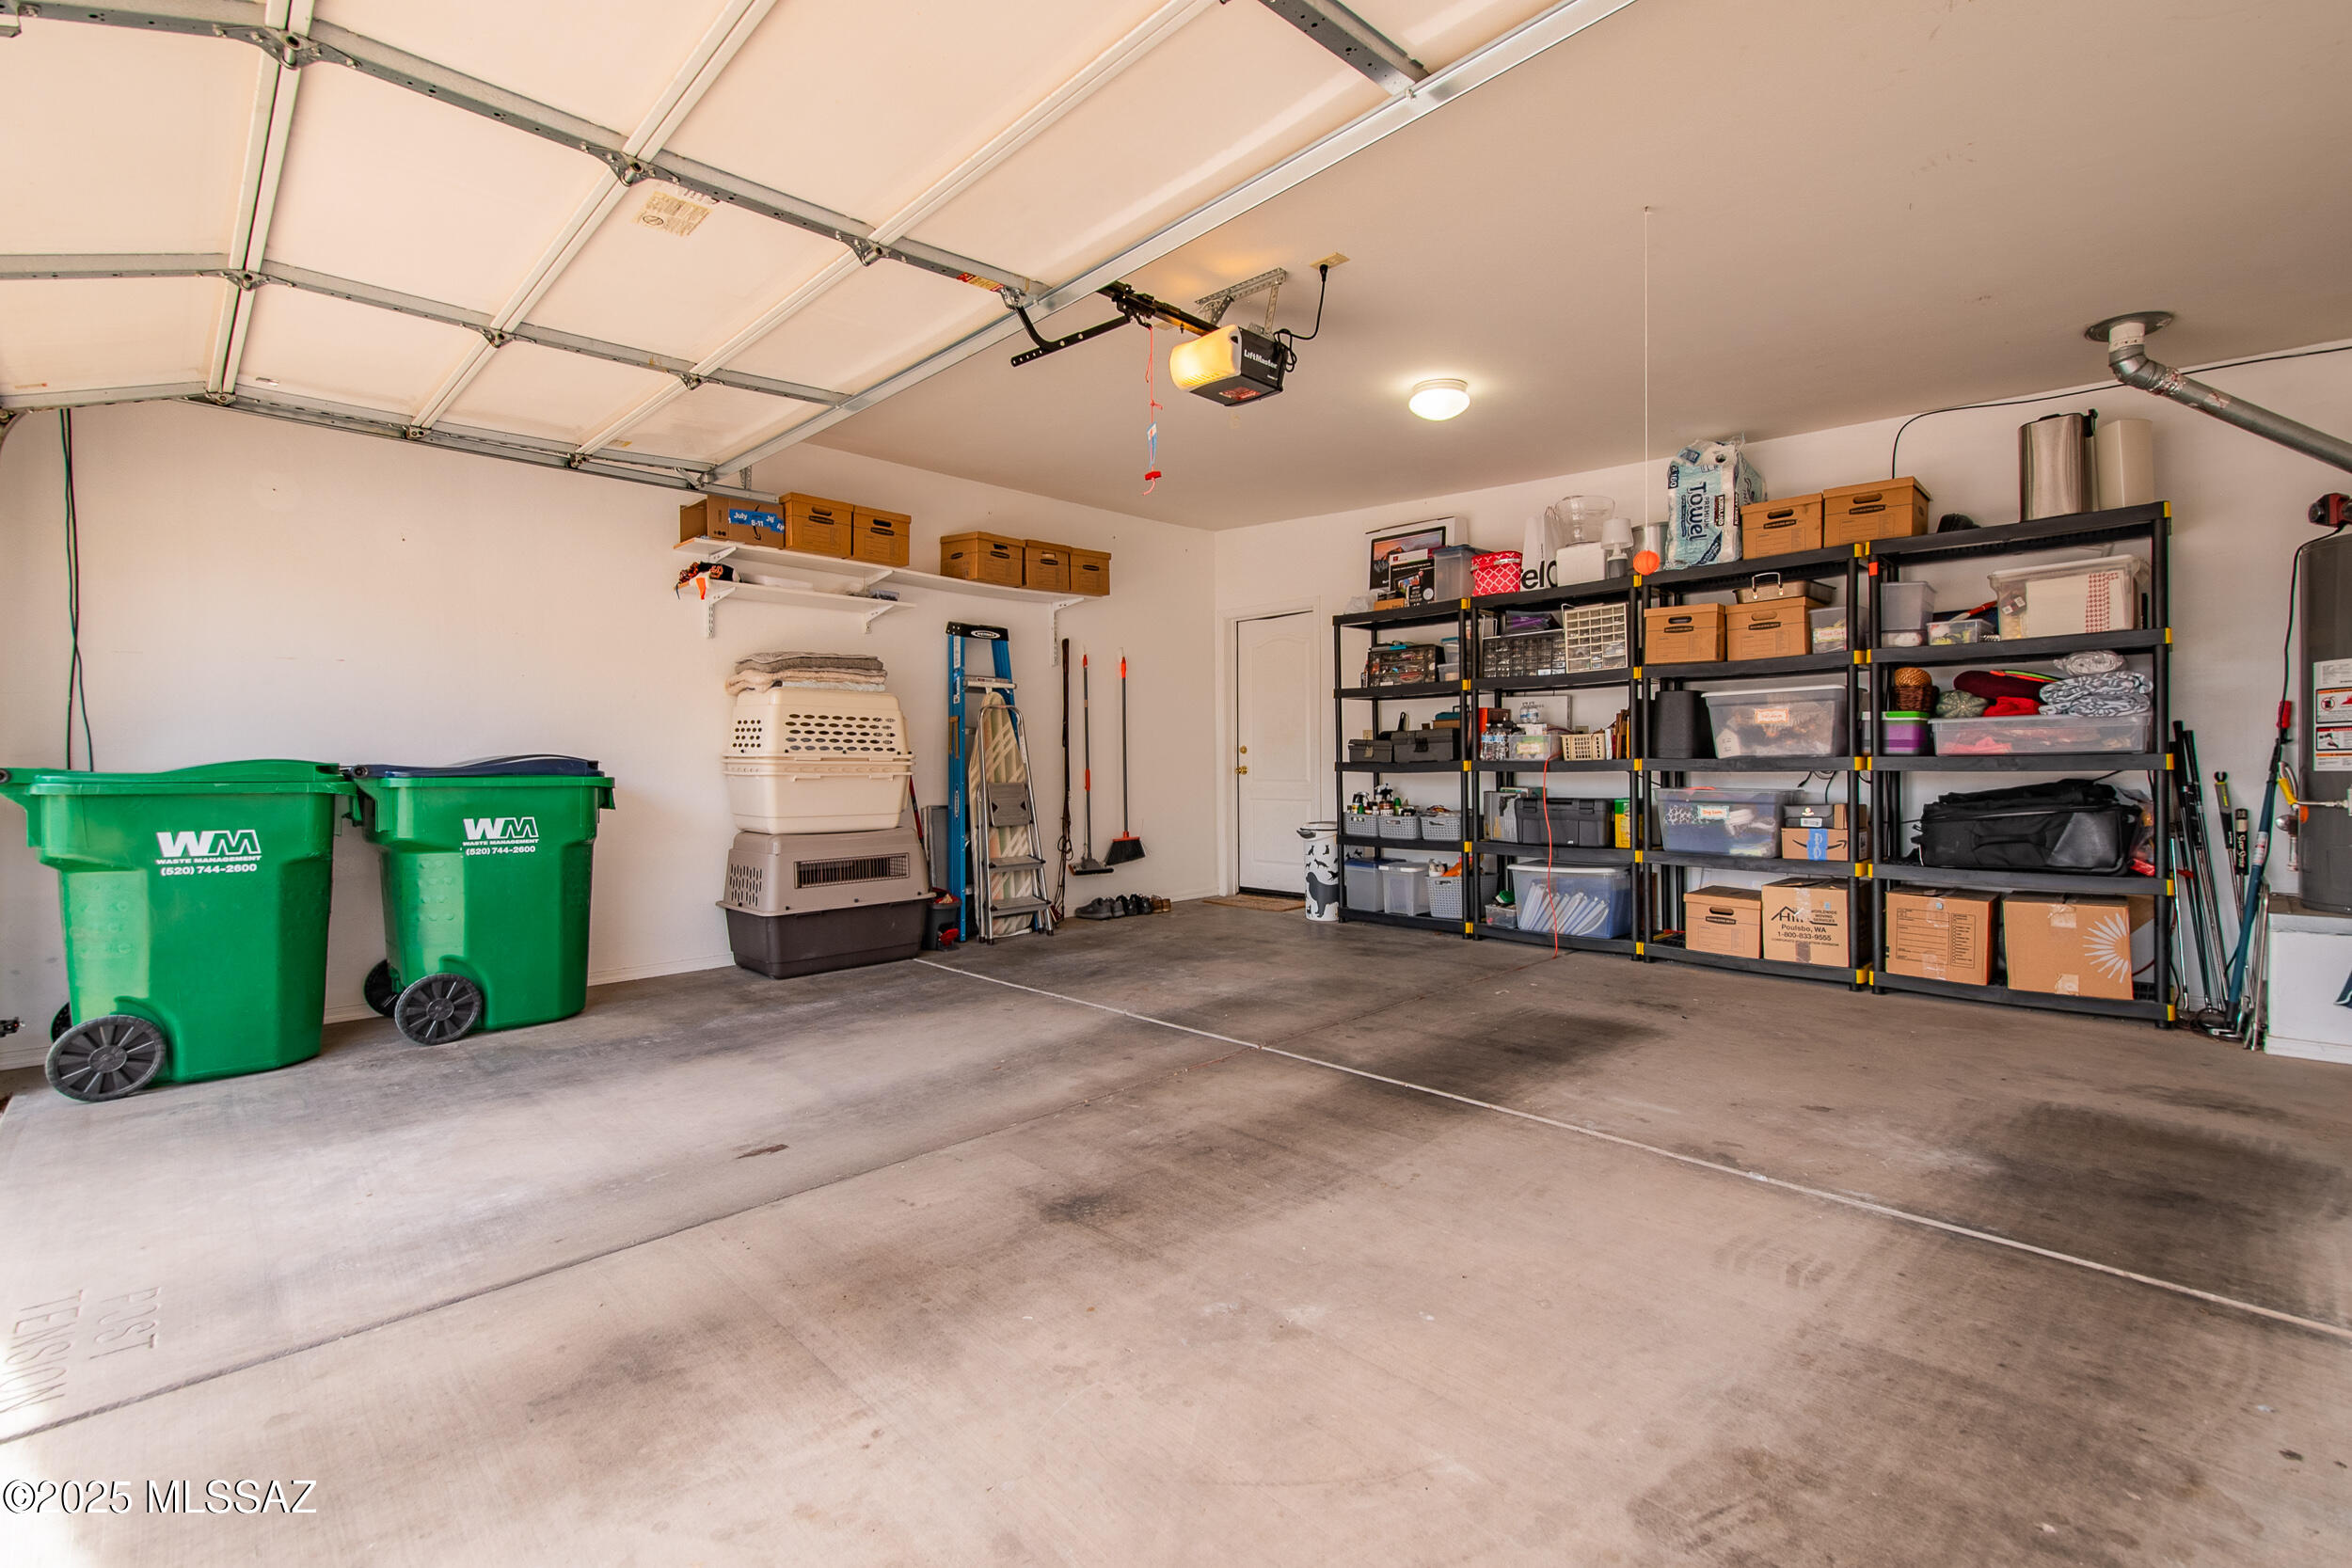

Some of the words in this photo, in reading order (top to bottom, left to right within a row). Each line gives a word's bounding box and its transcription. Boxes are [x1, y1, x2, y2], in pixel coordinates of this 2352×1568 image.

[1244, 349, 1278, 369] LiftMaster
[734, 512, 748, 520] July
[1690, 481, 1707, 540] Towel
[463, 816, 539, 840] WM
[156, 830, 262, 857] WM
[466, 847, 490, 856] (520)
[491, 846, 536, 854] 744-2600
[193, 855, 262, 863] MANAGEMENT
[160, 865, 195, 876] (520)
[197, 863, 258, 874] 744-2600
[1777, 931, 1832, 941] 1-800-833-9555
[1781, 924, 1813, 932] Poulsbo,
[89, 1287, 160, 1359] POST
[0, 1290, 83, 1412] TENSION
